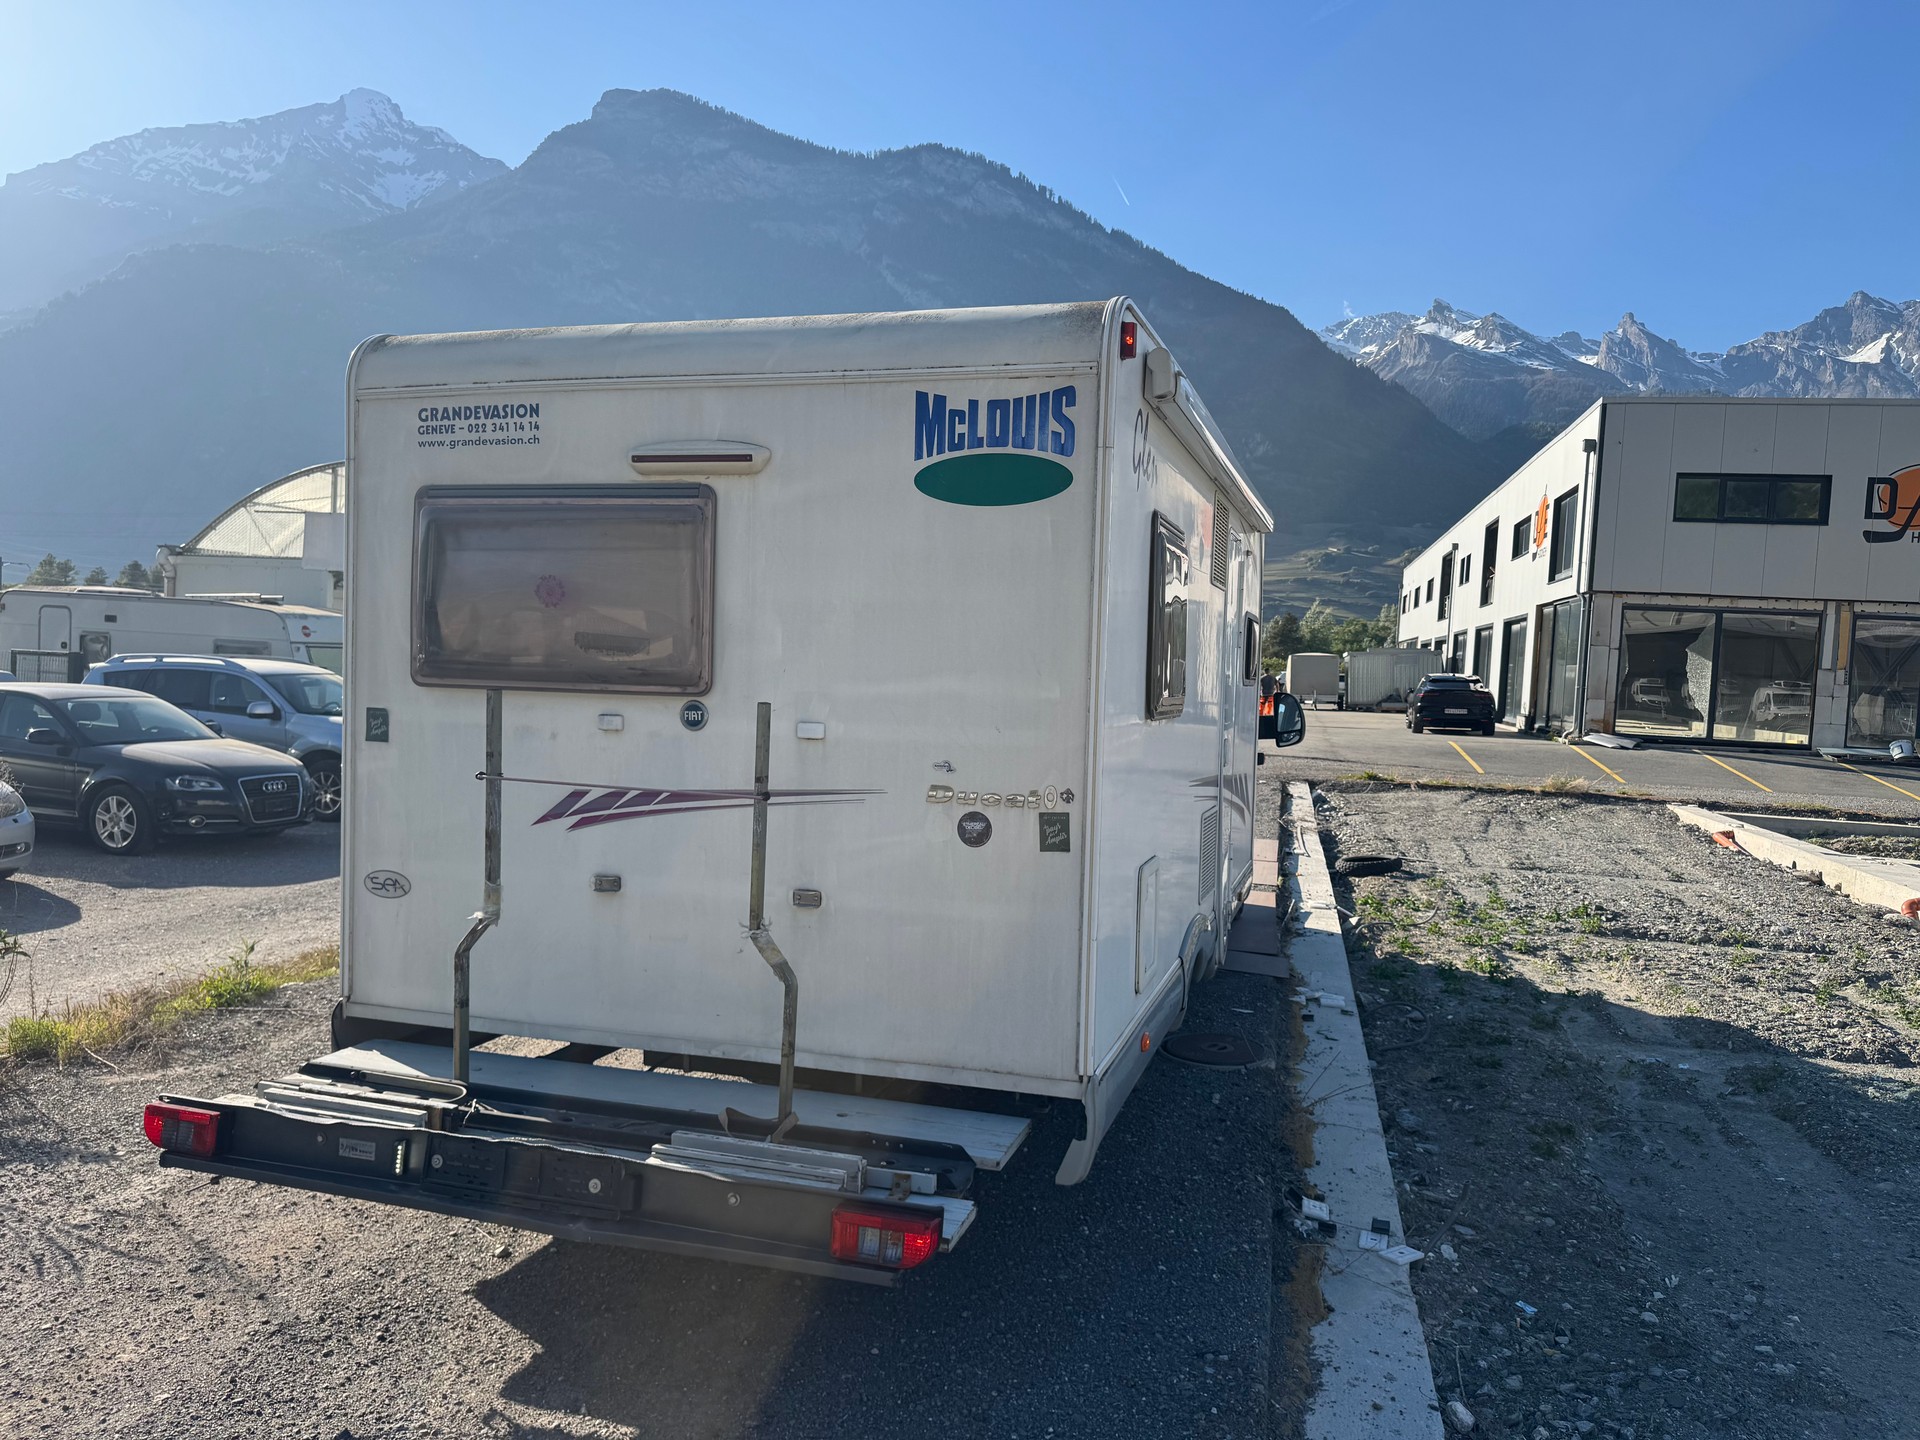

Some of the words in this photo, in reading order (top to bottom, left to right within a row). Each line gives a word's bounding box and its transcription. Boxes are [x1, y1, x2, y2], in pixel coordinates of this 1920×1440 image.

[418, 403, 540, 422] GRANDEVASION
[418, 424, 456, 435] GENEVE
[467, 423, 487, 433] 022
[491, 422, 510, 433] 341
[513, 421, 525, 432] 14
[528, 421, 540, 431] 14
[914, 385, 1077, 461] McLOUIS
[417, 434, 540, 450] www.grandevasion.ch
[684, 710, 703, 721] FIAT
[926, 784, 1058, 810] Ducato
